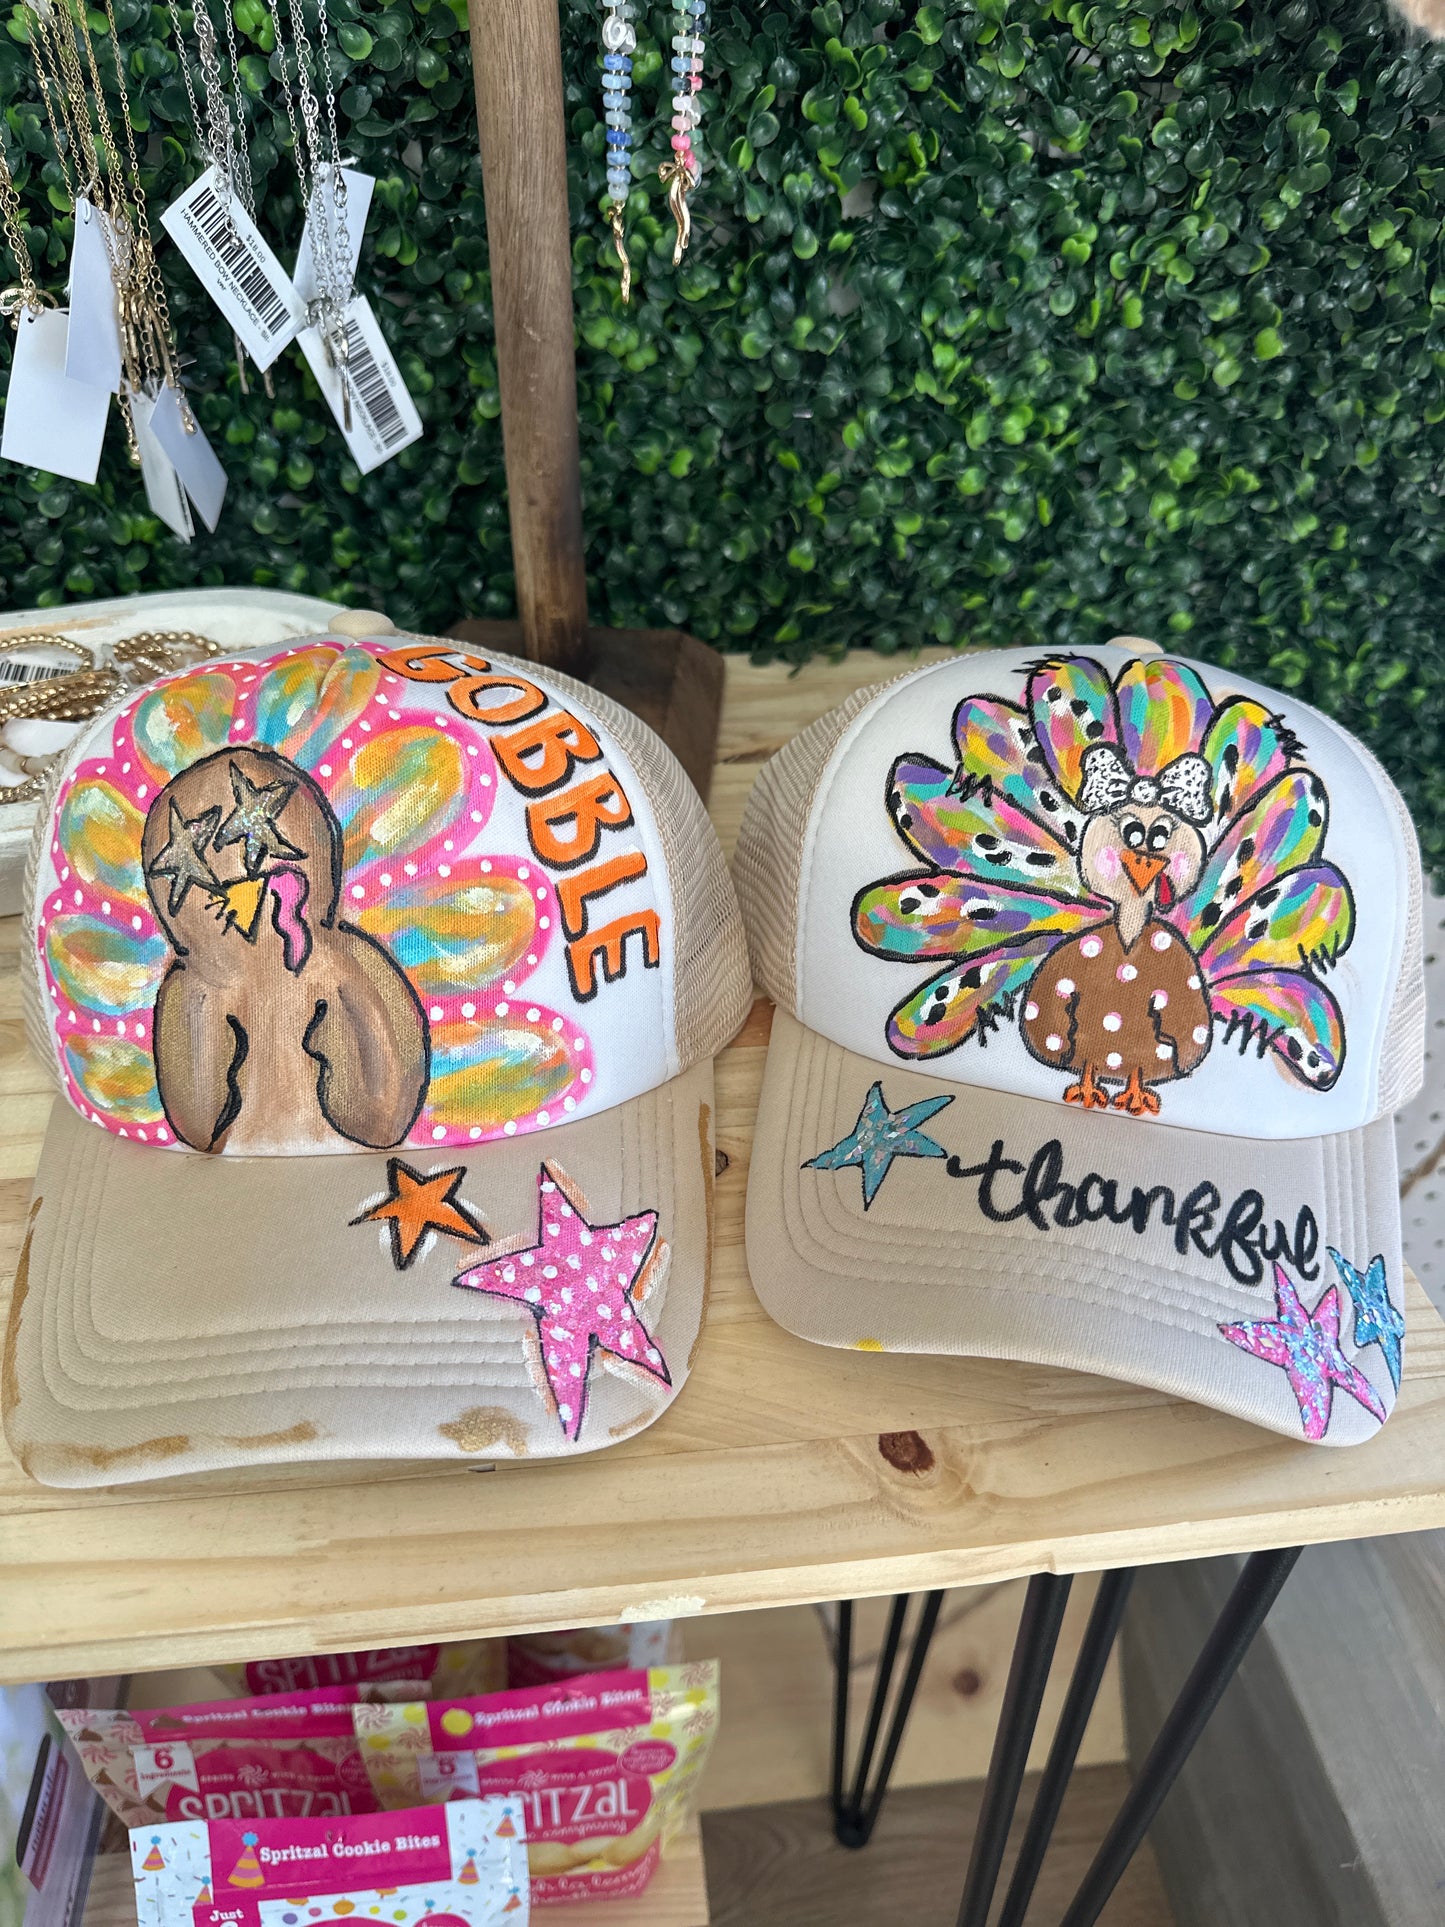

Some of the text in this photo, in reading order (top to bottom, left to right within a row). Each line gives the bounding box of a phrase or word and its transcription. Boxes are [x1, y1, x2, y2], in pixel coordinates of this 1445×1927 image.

[180, 208, 216, 261] HAMMERED
[214, 260, 231, 282] BOW
[229, 281, 261, 326] NECKLACE
[246, 234, 266, 264] $18.00
[376, 646, 661, 1003] GOBBLE
[946, 1138, 1321, 1287] thankful
[259, 1833, 441, 1865] Spritzal Cookie Bites
[209, 1908, 244, 1922] Just
